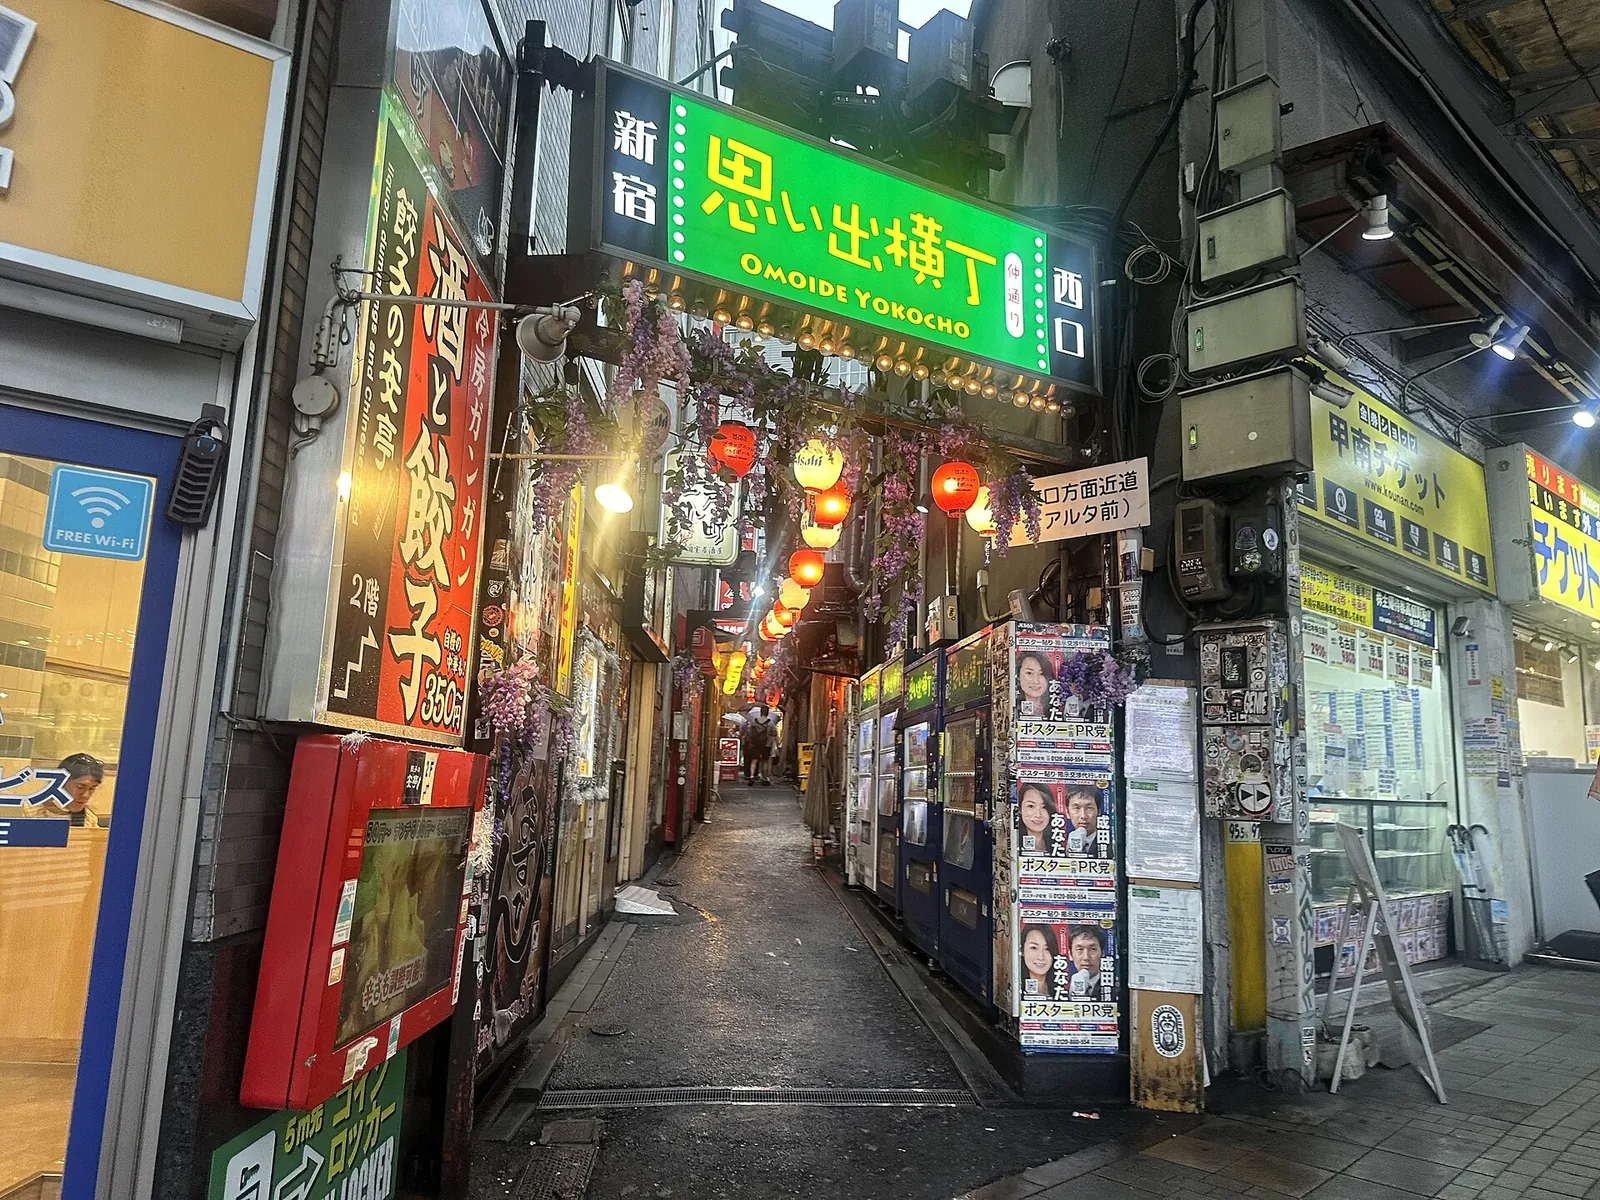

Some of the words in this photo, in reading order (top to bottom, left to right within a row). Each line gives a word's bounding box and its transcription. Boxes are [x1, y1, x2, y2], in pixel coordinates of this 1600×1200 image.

[612, 109, 660, 227] 新宿
[700, 134, 998, 307] 思い出横丁
[740, 251, 848, 304] OMOIDE
[853, 287, 972, 341] YOKOCHO
[1006, 262, 1021, 329] 仲通り
[1052, 265, 1086, 360] 西口
[366, 340, 377, 382] and
[457, 296, 490, 587] 冷房ガンガン
[1359, 404, 1418, 453] 金券ショップ
[389, 211, 470, 723] 酒と餃子
[1328, 411, 1446, 510] 甲南チケット
[1526, 454, 1580, 502] 売ります
[1363, 477, 1426, 516] www.kounan.com
[1528, 480, 1581, 528] 買います
[56, 529, 91, 544] FREE
[95, 534, 134, 550] Wi-Fi
[1534, 518, 1600, 609] チケット
[350, 573, 380, 618] 2階
[1049, 679, 1063, 722] あなた
[1051, 813, 1066, 857] あなた
[1096, 814, 1110, 844] 成田
[1053, 954, 1069, 1001] あなた
[1100, 956, 1114, 987] 成田
[333, 1061, 389, 1127] コイン
[328, 1101, 396, 1184] ロッカー
